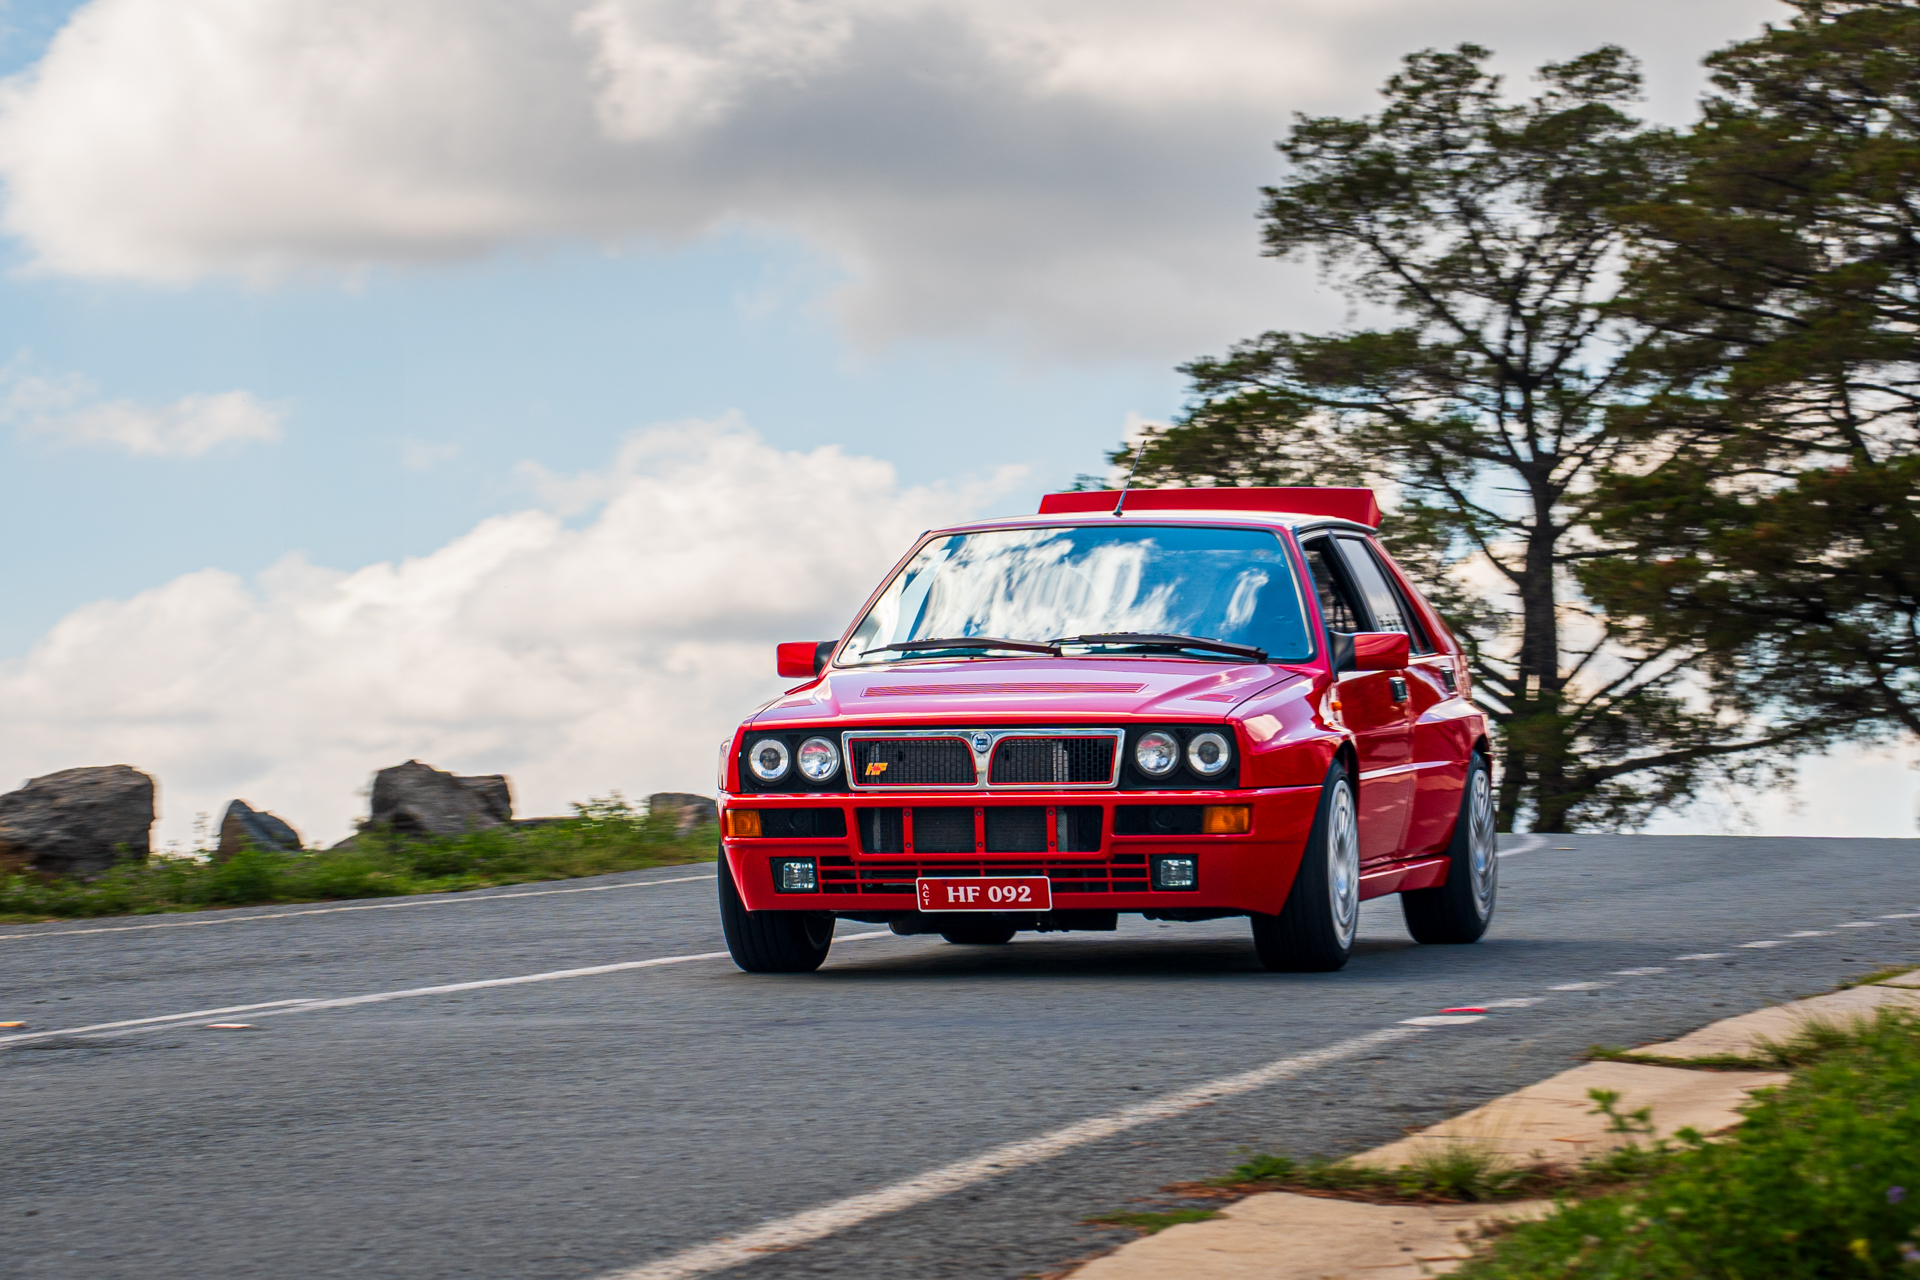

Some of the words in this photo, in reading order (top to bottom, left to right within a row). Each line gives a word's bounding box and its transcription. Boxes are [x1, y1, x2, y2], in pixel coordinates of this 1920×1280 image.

[865, 762, 888, 776] HF
[922, 883, 930, 906] ACT
[946, 886, 981, 903] HF
[987, 885, 1032, 903] 092
